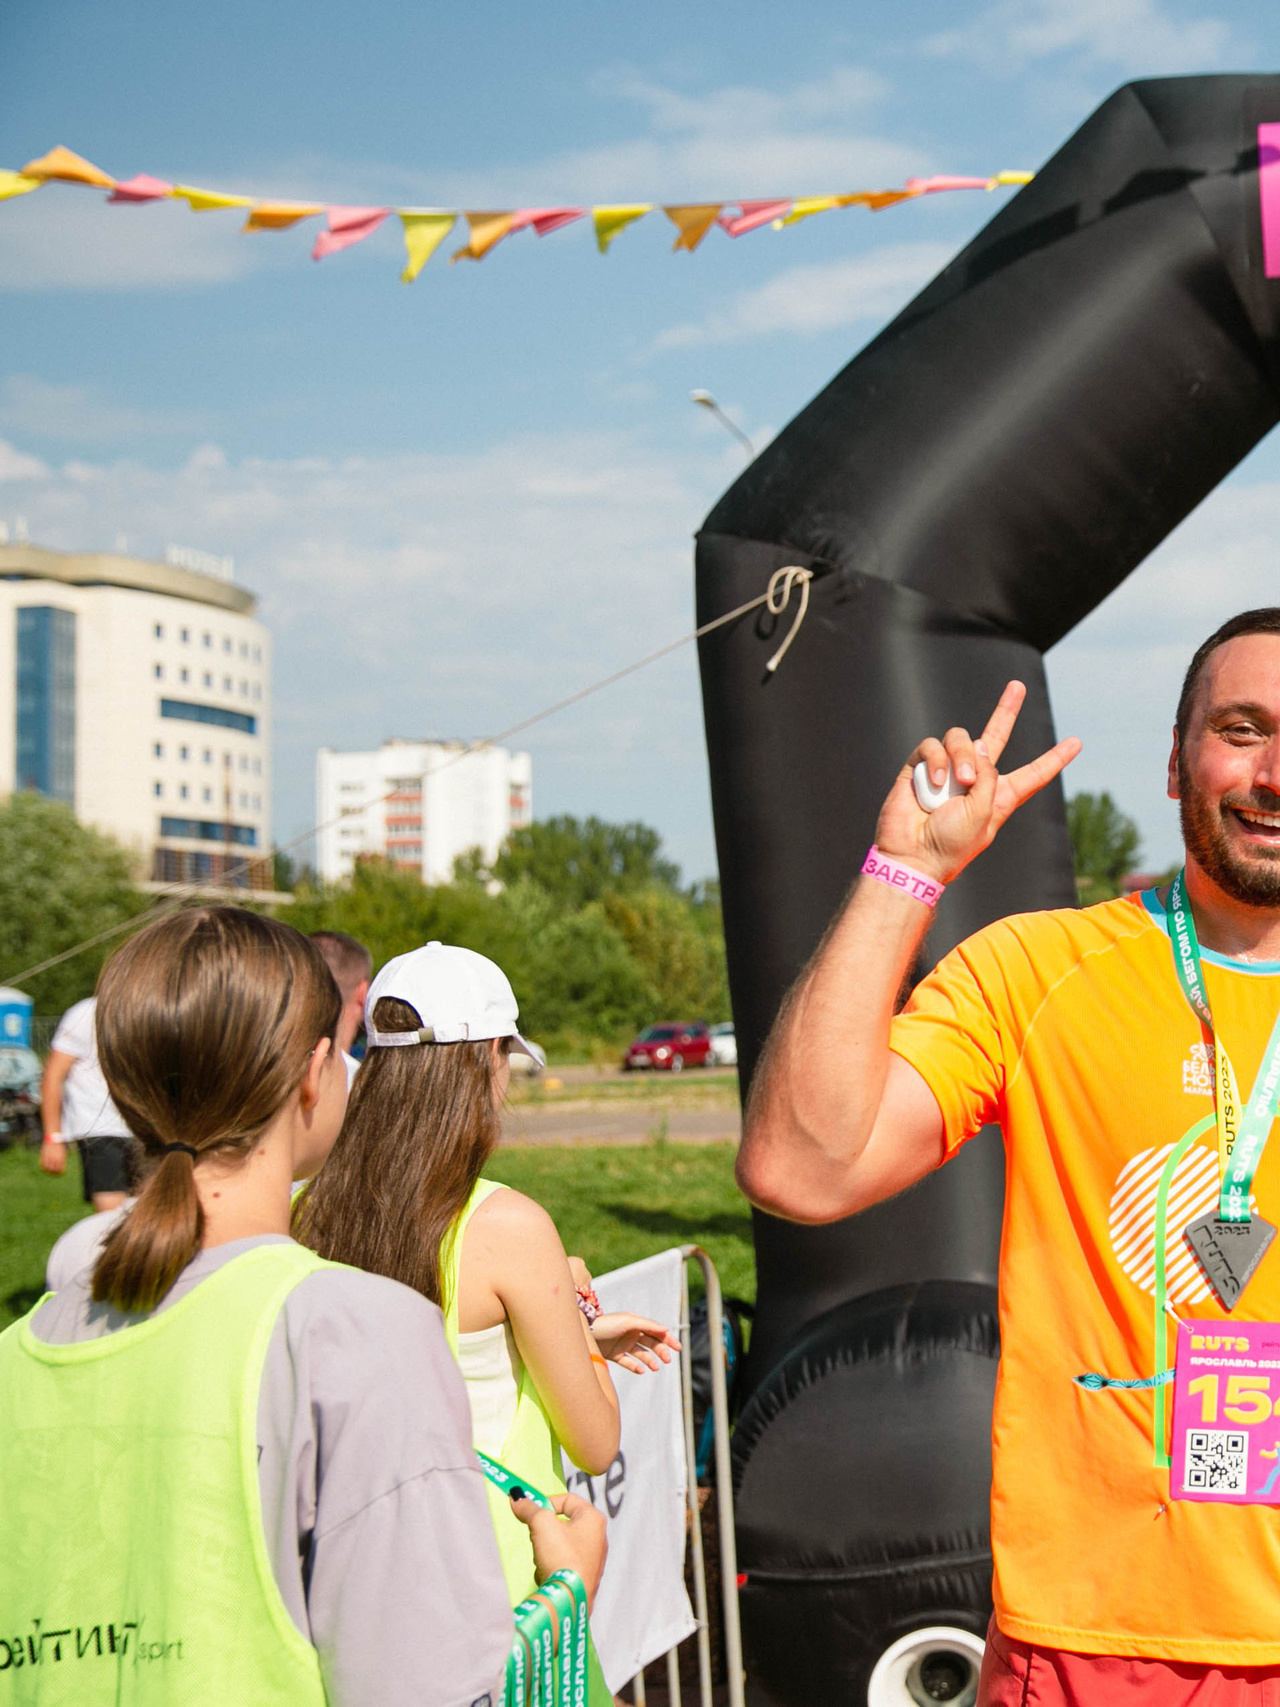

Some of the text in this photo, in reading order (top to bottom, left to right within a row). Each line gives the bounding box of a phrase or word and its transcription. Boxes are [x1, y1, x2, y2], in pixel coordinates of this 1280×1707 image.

[1173, 911, 1187, 930] ПО
[1177, 931, 1198, 986] БЕГОМ
[1229, 1134, 1258, 1222] RUTS 202
[1190, 1335, 1250, 1352] RUTS
[1190, 1356, 1257, 1369] ЯРОСЛАВЛЬ
[477, 1454, 509, 1483] 023
